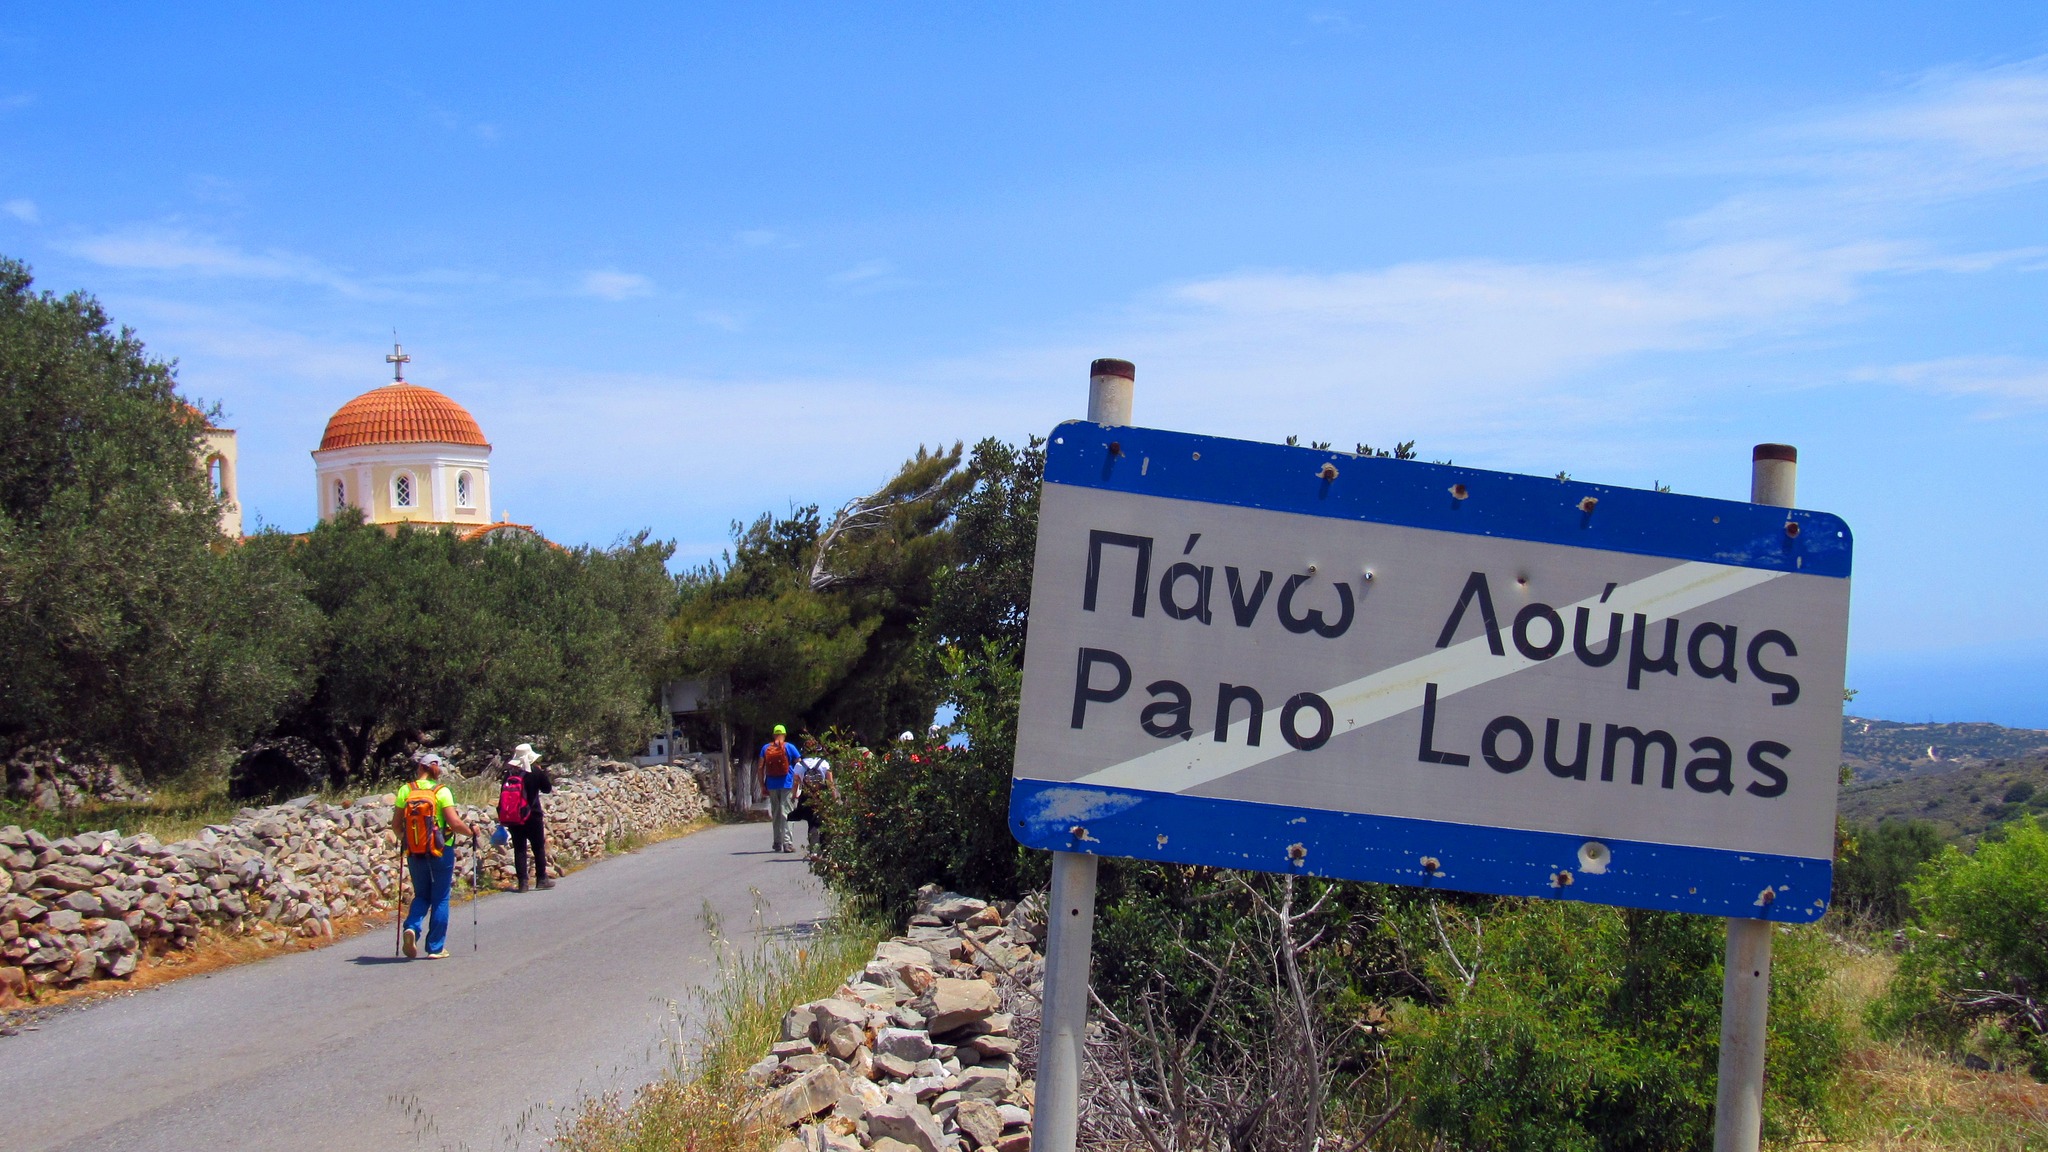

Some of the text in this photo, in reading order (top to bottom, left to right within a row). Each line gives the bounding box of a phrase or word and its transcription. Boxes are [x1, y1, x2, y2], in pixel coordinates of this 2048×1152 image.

[1083, 529, 1801, 707] Πάνω Λούμας
[1071, 647, 1792, 799] Pano Loumas
